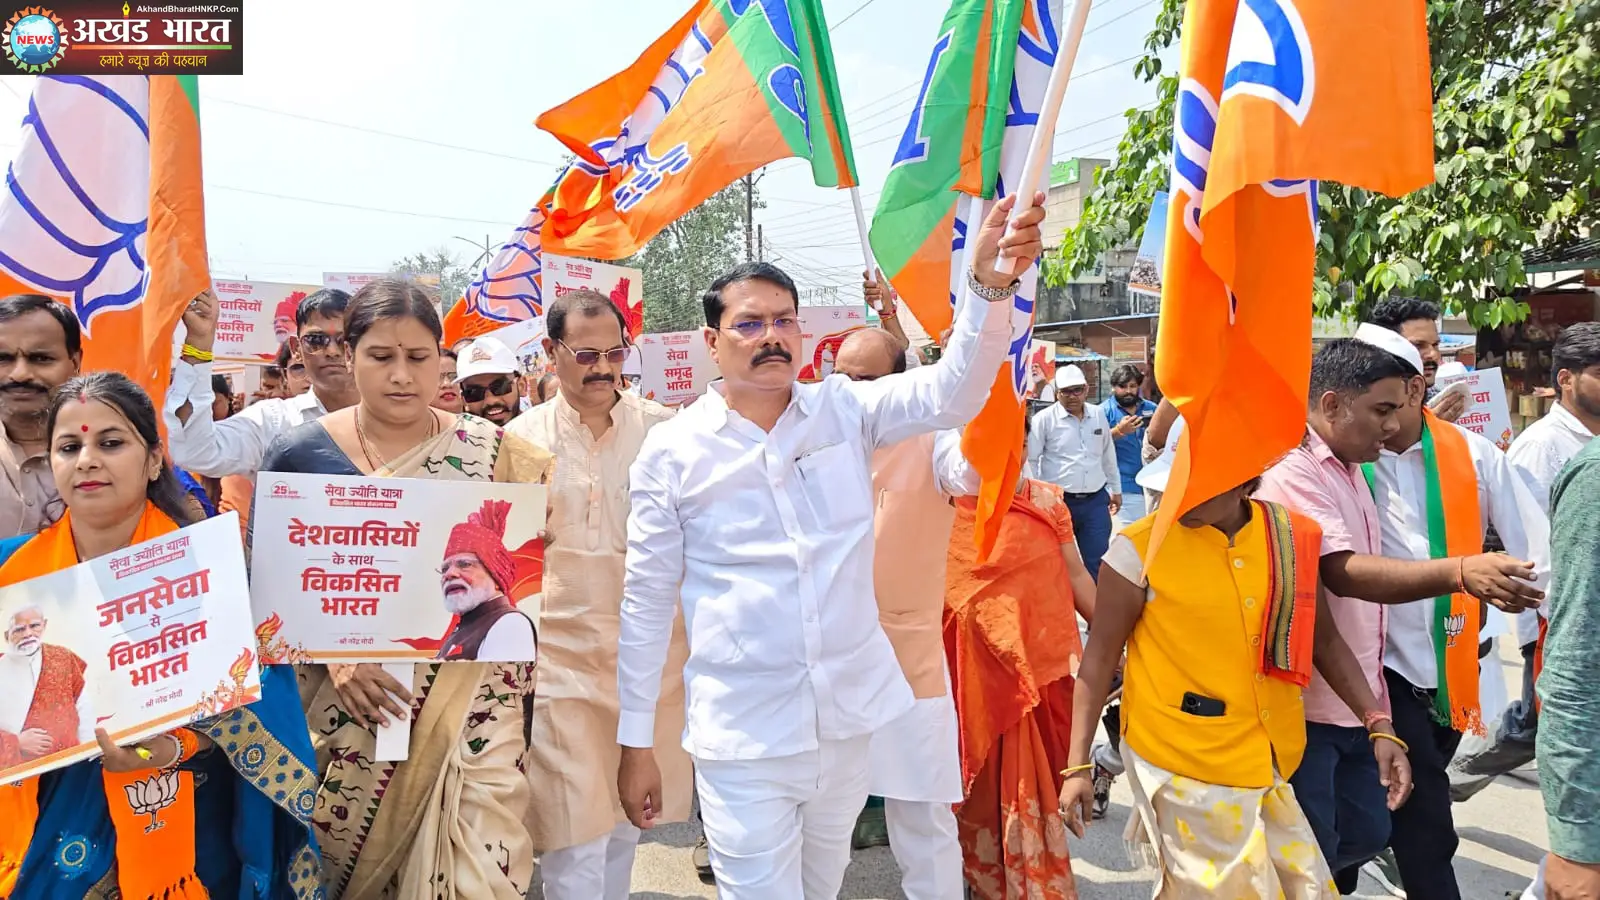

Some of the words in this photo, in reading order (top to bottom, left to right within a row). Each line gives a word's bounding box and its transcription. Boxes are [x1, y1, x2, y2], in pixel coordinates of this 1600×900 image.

[216, 332, 244, 342] भारत
[666, 348, 688, 360] सेवा
[664, 367, 693, 380] समृद्ध
[666, 381, 692, 391] भारत
[273, 485, 288, 495] 25
[325, 484, 345, 497] सेवा
[349, 484, 378, 498] ज्योति
[381, 488, 403, 500] यात्रा
[288, 518, 420, 547] देशवासियों
[109, 555, 130, 571] सेवा
[134, 543, 164, 562] ज्योति
[165, 535, 190, 551] यात्रा
[332, 551, 345, 565] के
[349, 555, 374, 566] साथ
[301, 567, 401, 593] विकसित
[96, 568, 211, 627] जनसेवा
[321, 597, 379, 616] भारत
[149, 614, 161, 627] से
[107, 620, 208, 671] विकसित
[130, 652, 189, 688] भारत
